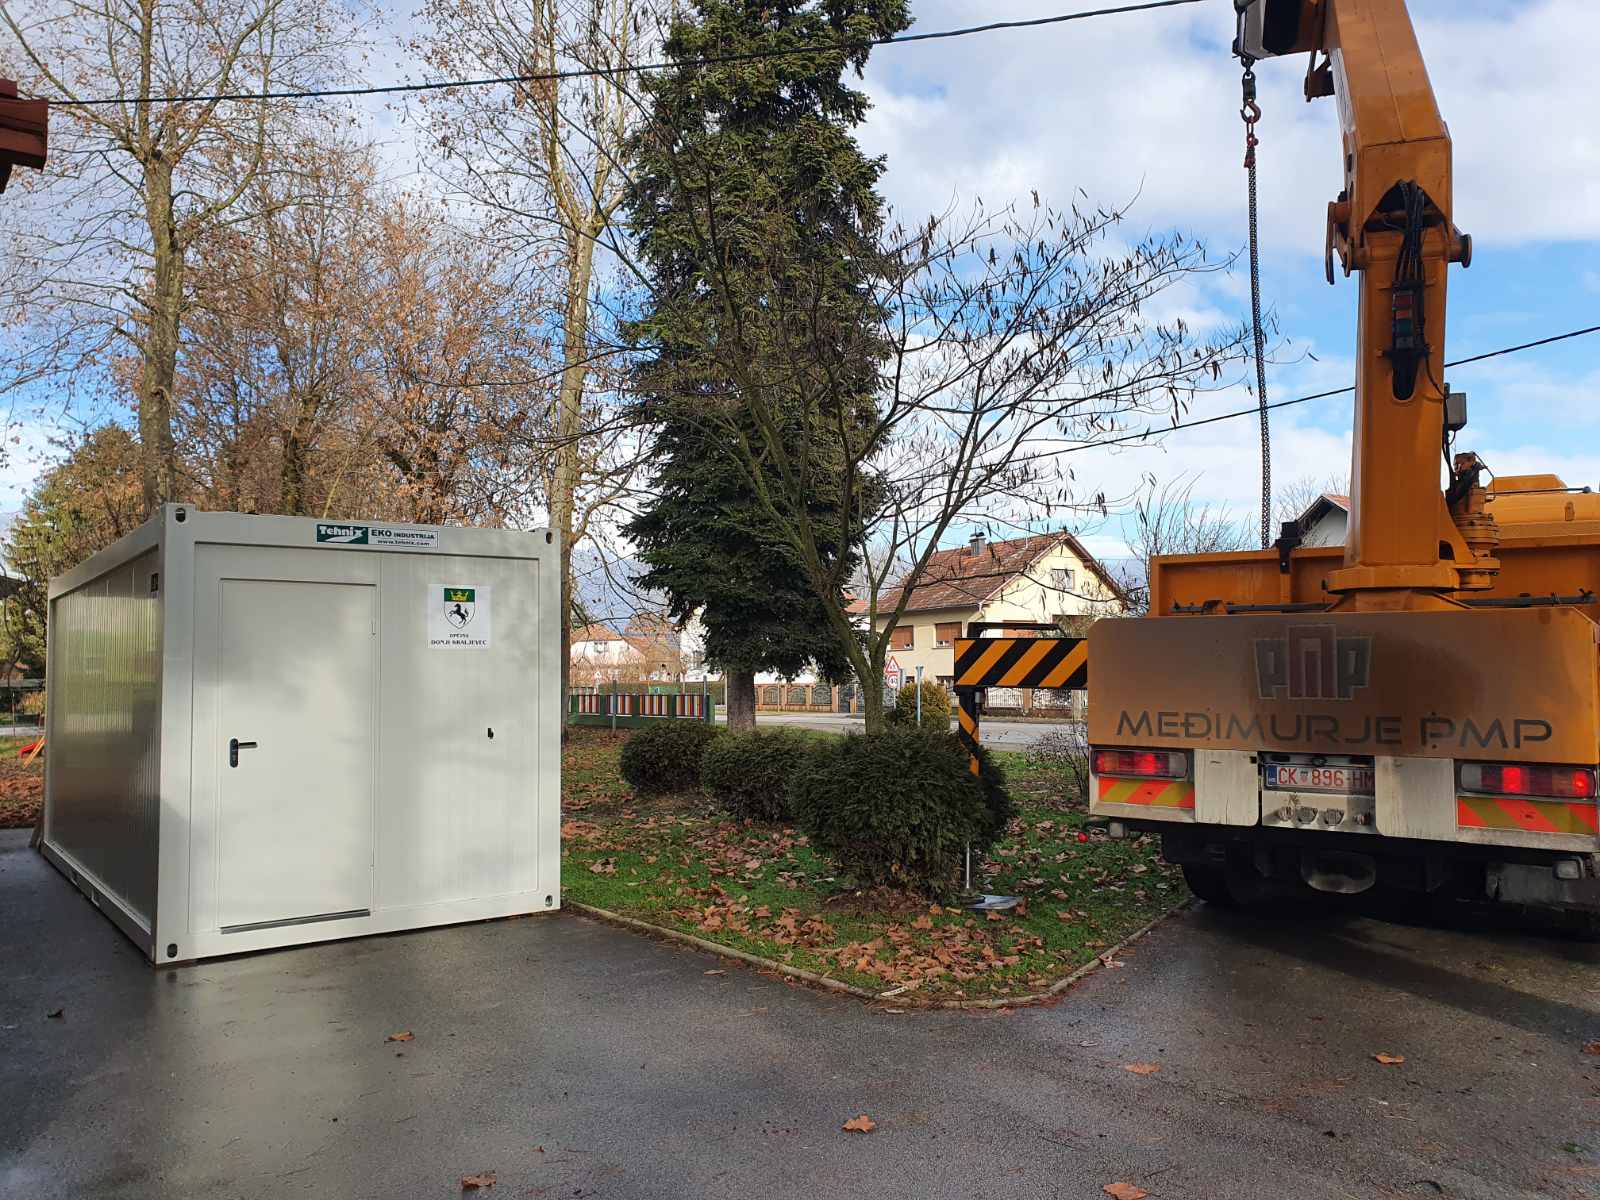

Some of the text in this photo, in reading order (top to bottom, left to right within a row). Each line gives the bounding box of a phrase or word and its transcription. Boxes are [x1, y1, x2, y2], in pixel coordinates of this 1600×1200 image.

[319, 525, 364, 537] Tehnix
[371, 529, 435, 540] EKO INDUSTRIJA
[1116, 710, 1553, 750] MEĐIMURJE PMP
[1279, 767, 1298, 785] CK
